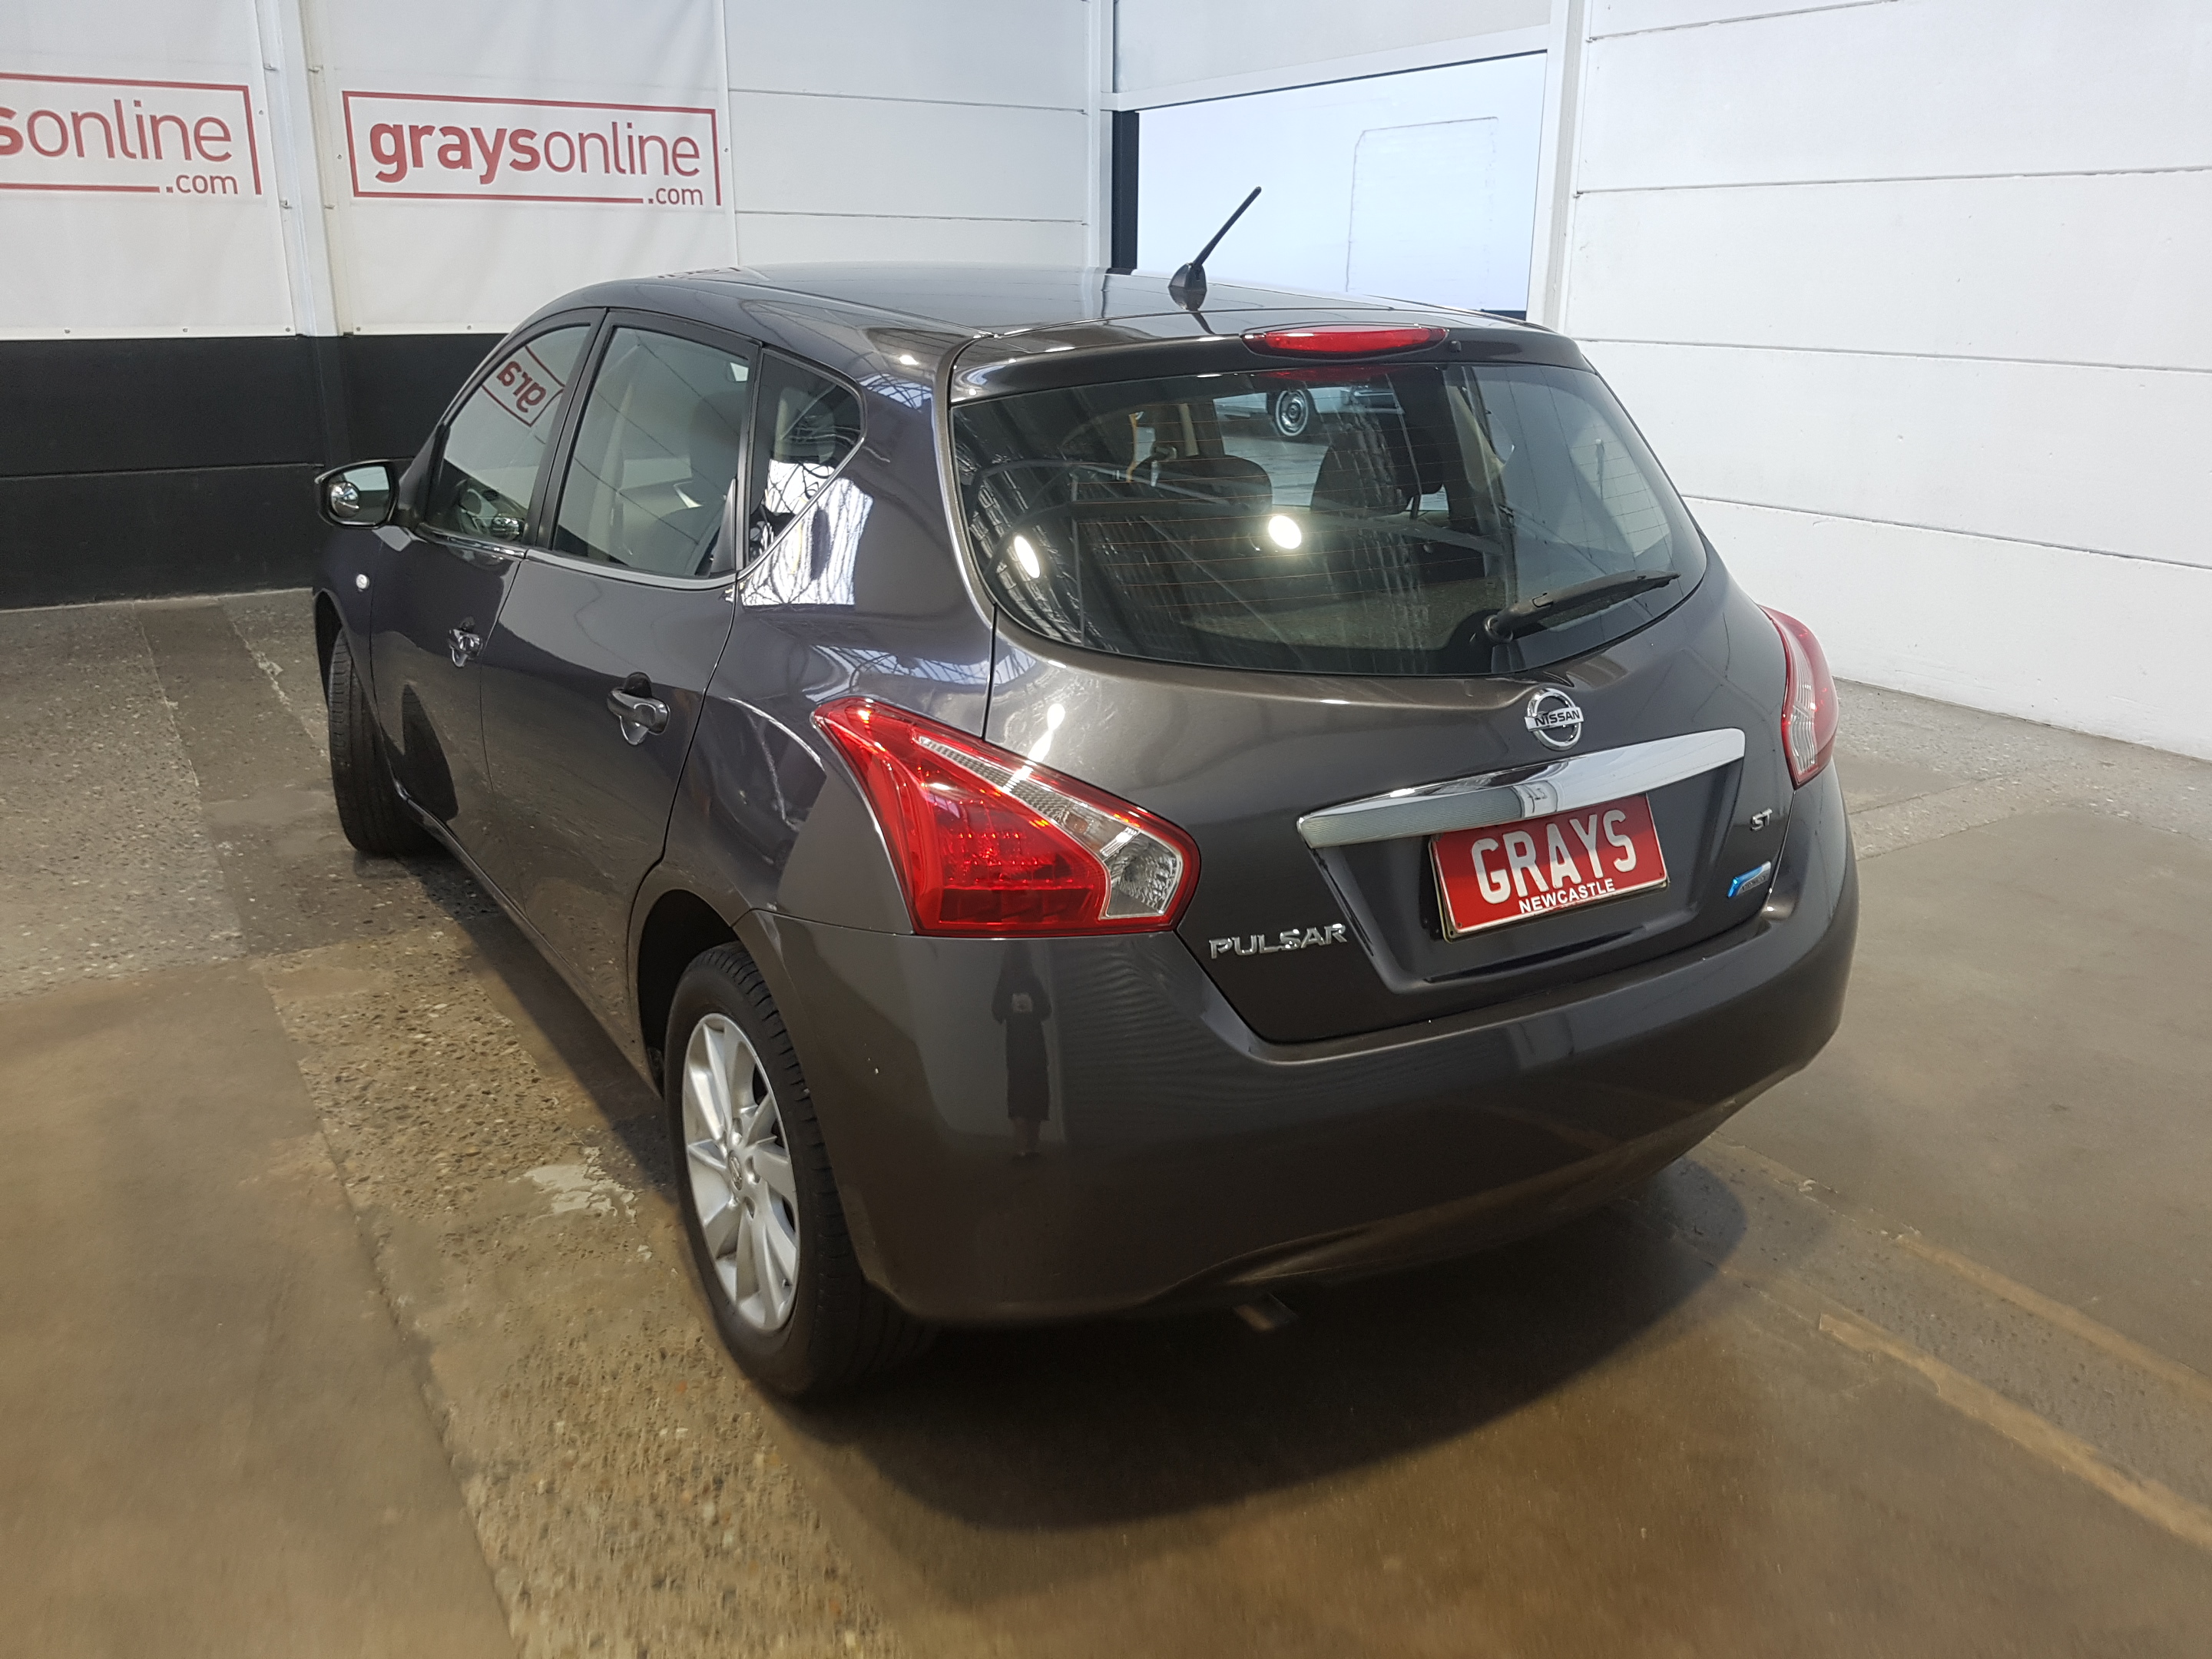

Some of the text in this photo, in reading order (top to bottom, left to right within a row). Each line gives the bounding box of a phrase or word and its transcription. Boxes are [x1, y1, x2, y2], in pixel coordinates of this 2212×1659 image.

[369, 121, 700, 184] graysonline
[166, 174, 238, 195] .com
[647, 186, 704, 205] .com
[1535, 708, 1581, 727] NISSAN
[1750, 808, 1773, 831] ST
[1471, 810, 1637, 904] GRAYS
[1518, 877, 1616, 914] NEWCASTLE
[1208, 923, 1347, 959] PULSAR
